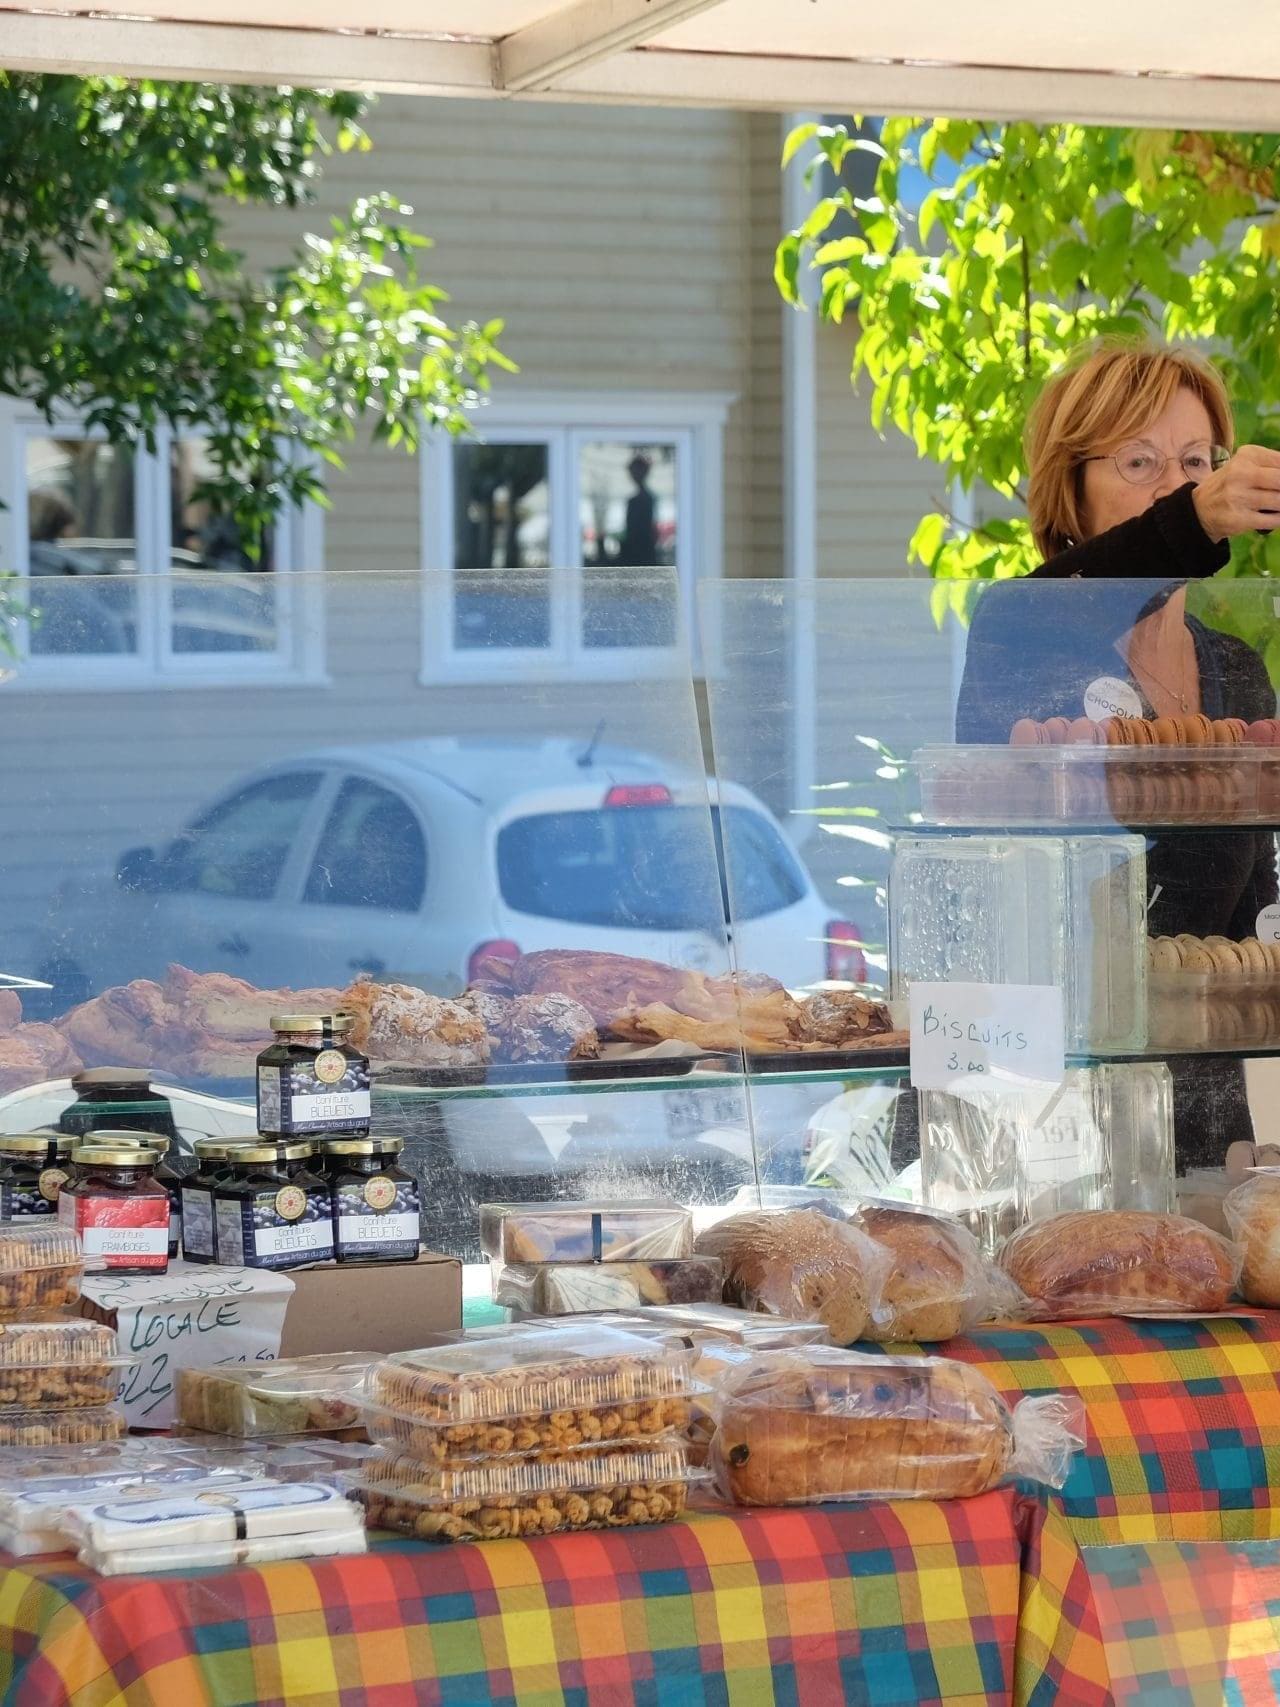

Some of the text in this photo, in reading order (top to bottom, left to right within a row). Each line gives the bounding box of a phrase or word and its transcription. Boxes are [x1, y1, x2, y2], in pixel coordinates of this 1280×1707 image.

[1086, 693, 1140, 720] CHOCOLA
[310, 1104, 355, 1118] BLEUETS
[278, 1225, 311, 1237] Confiture
[358, 1225, 403, 1239] BLEUETS
[274, 1235, 317, 1250] BLEUETS
[130, 1299, 241, 1351] LOCALE
